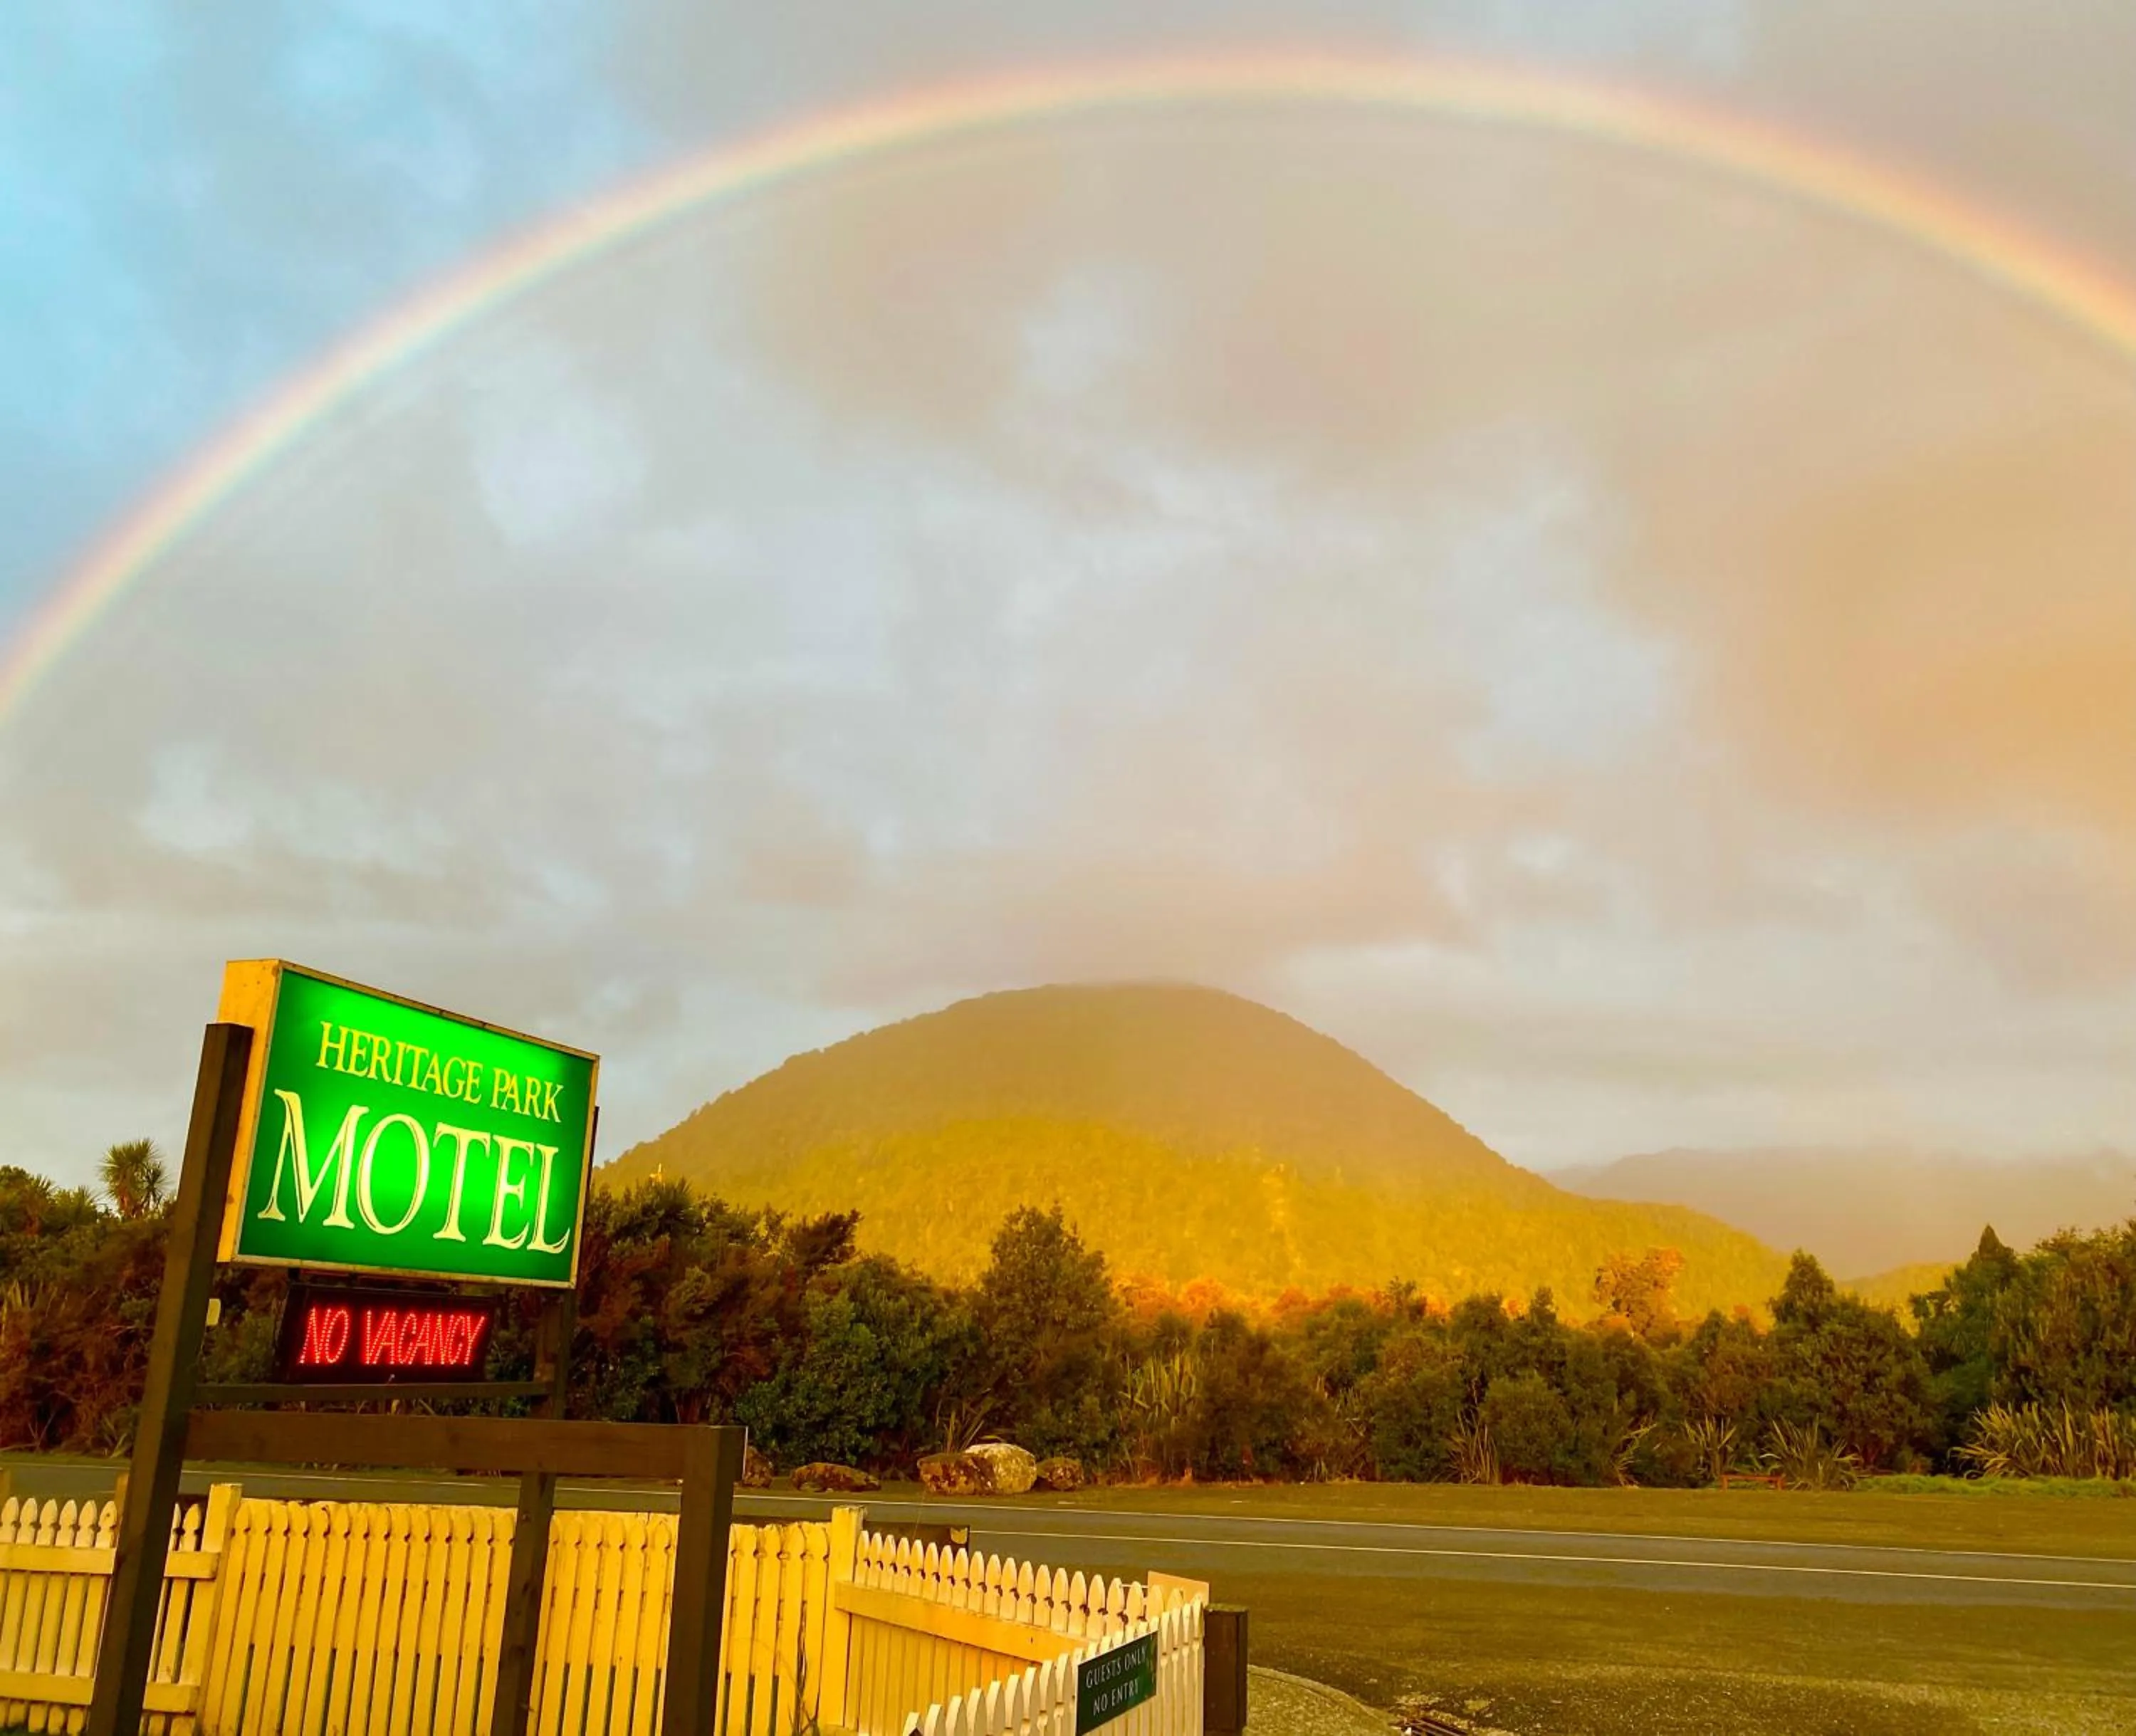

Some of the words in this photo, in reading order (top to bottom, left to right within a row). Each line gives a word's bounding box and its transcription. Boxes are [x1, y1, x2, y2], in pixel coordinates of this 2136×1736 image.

[315, 1020, 483, 1104] HERITAGE
[490, 1067, 564, 1124] PARK
[257, 1088, 570, 1254] MOTEL
[298, 1306, 351, 1365] NO
[363, 1309, 487, 1366] VACANCY
[1086, 1657, 1121, 1689] GUESTS
[1124, 1643, 1147, 1670] ONLY
[1092, 1693, 1108, 1717] NO
[1111, 1676, 1139, 1707] ENTRY
